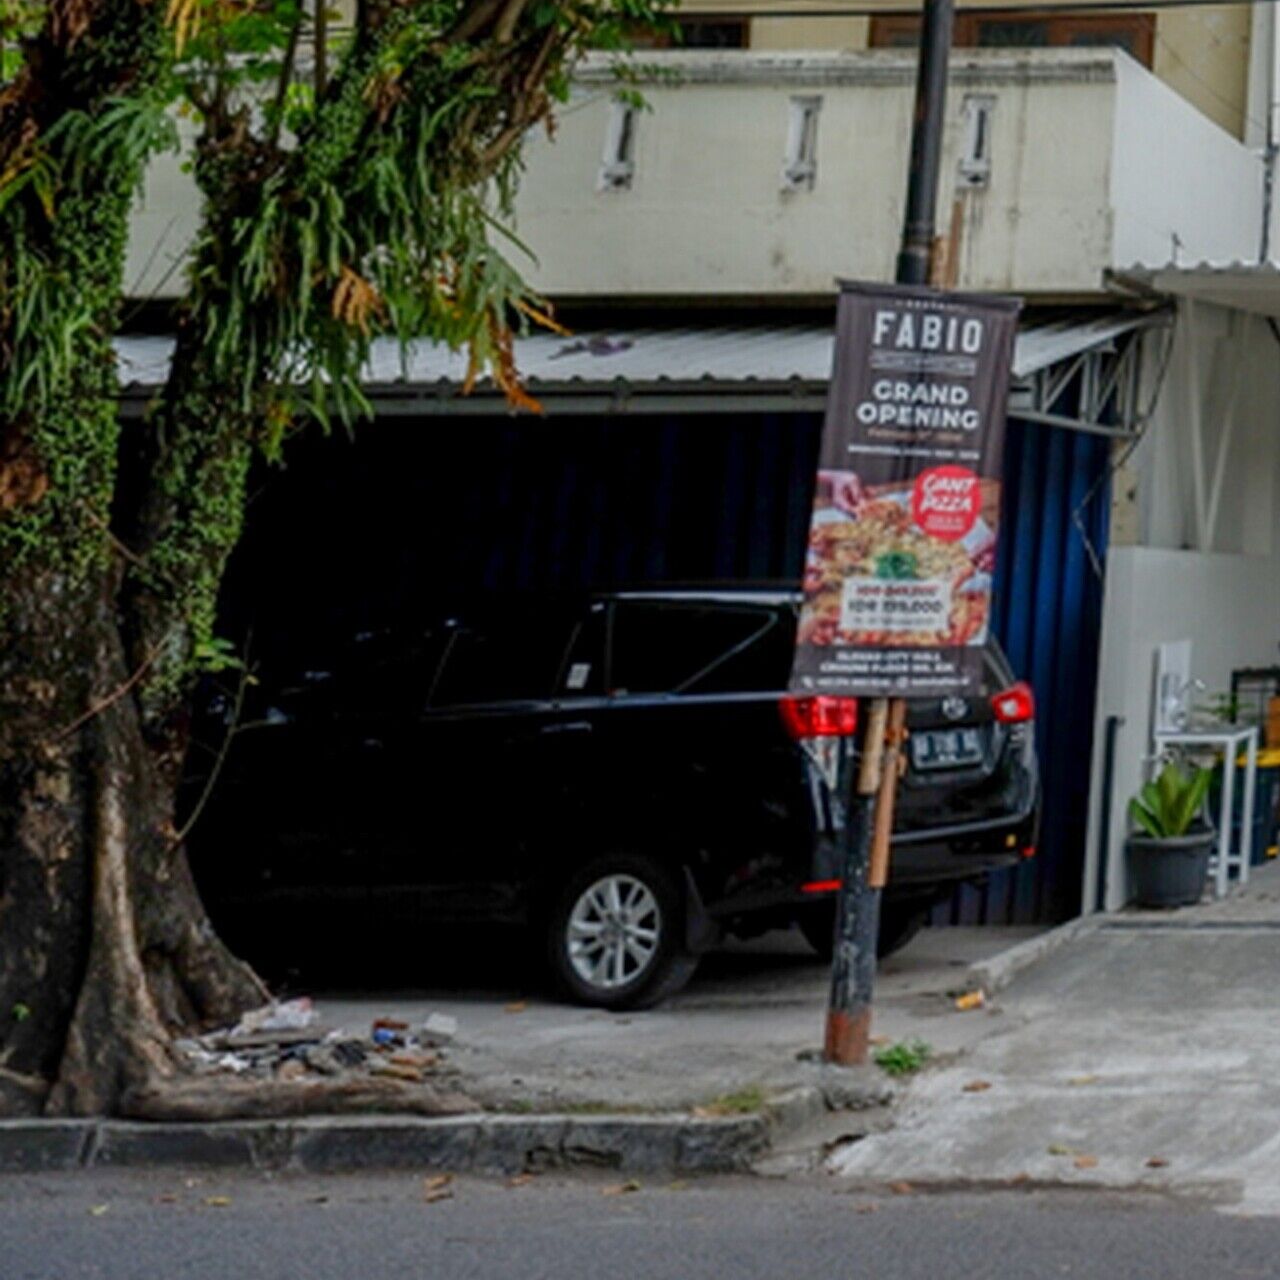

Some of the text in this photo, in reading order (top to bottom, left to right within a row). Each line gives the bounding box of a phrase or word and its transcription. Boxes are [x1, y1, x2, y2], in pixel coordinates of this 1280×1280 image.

[873, 311, 983, 353] FABIO
[873, 380, 969, 405] GRAND
[856, 402, 980, 430] OPENING
